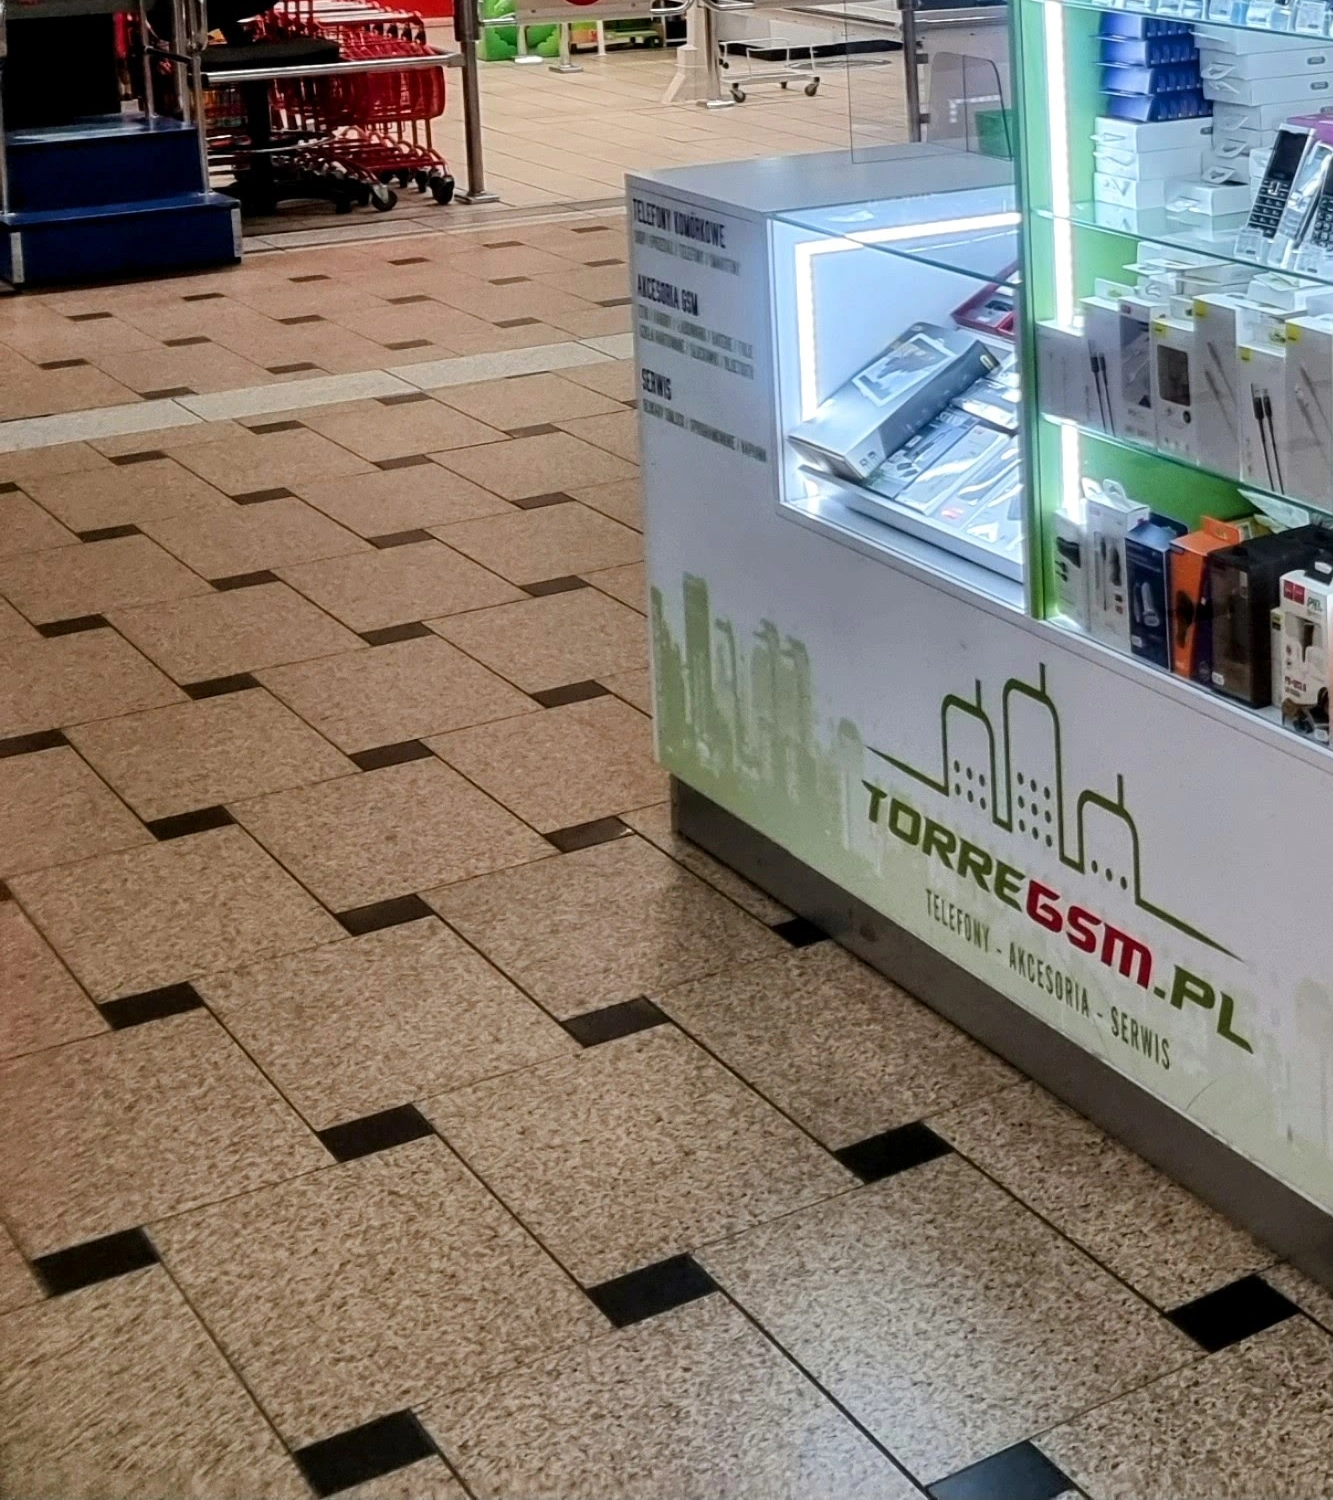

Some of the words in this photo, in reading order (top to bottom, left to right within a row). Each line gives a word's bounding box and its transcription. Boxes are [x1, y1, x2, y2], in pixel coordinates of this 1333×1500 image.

[632, 199, 671, 232] TELEFONY
[674, 211, 726, 248] KOMÓRKOWE
[637, 274, 680, 310] AKCESORIA
[681, 289, 699, 316] GSM
[642, 368, 672, 401] SERWIS
[861, 779, 1254, 1054] TORREGSM.PL
[925, 888, 990, 954] TELEFONY
[1009, 941, 1090, 1018] AKCESORIA
[1110, 1005, 1171, 1071] SERWIS
